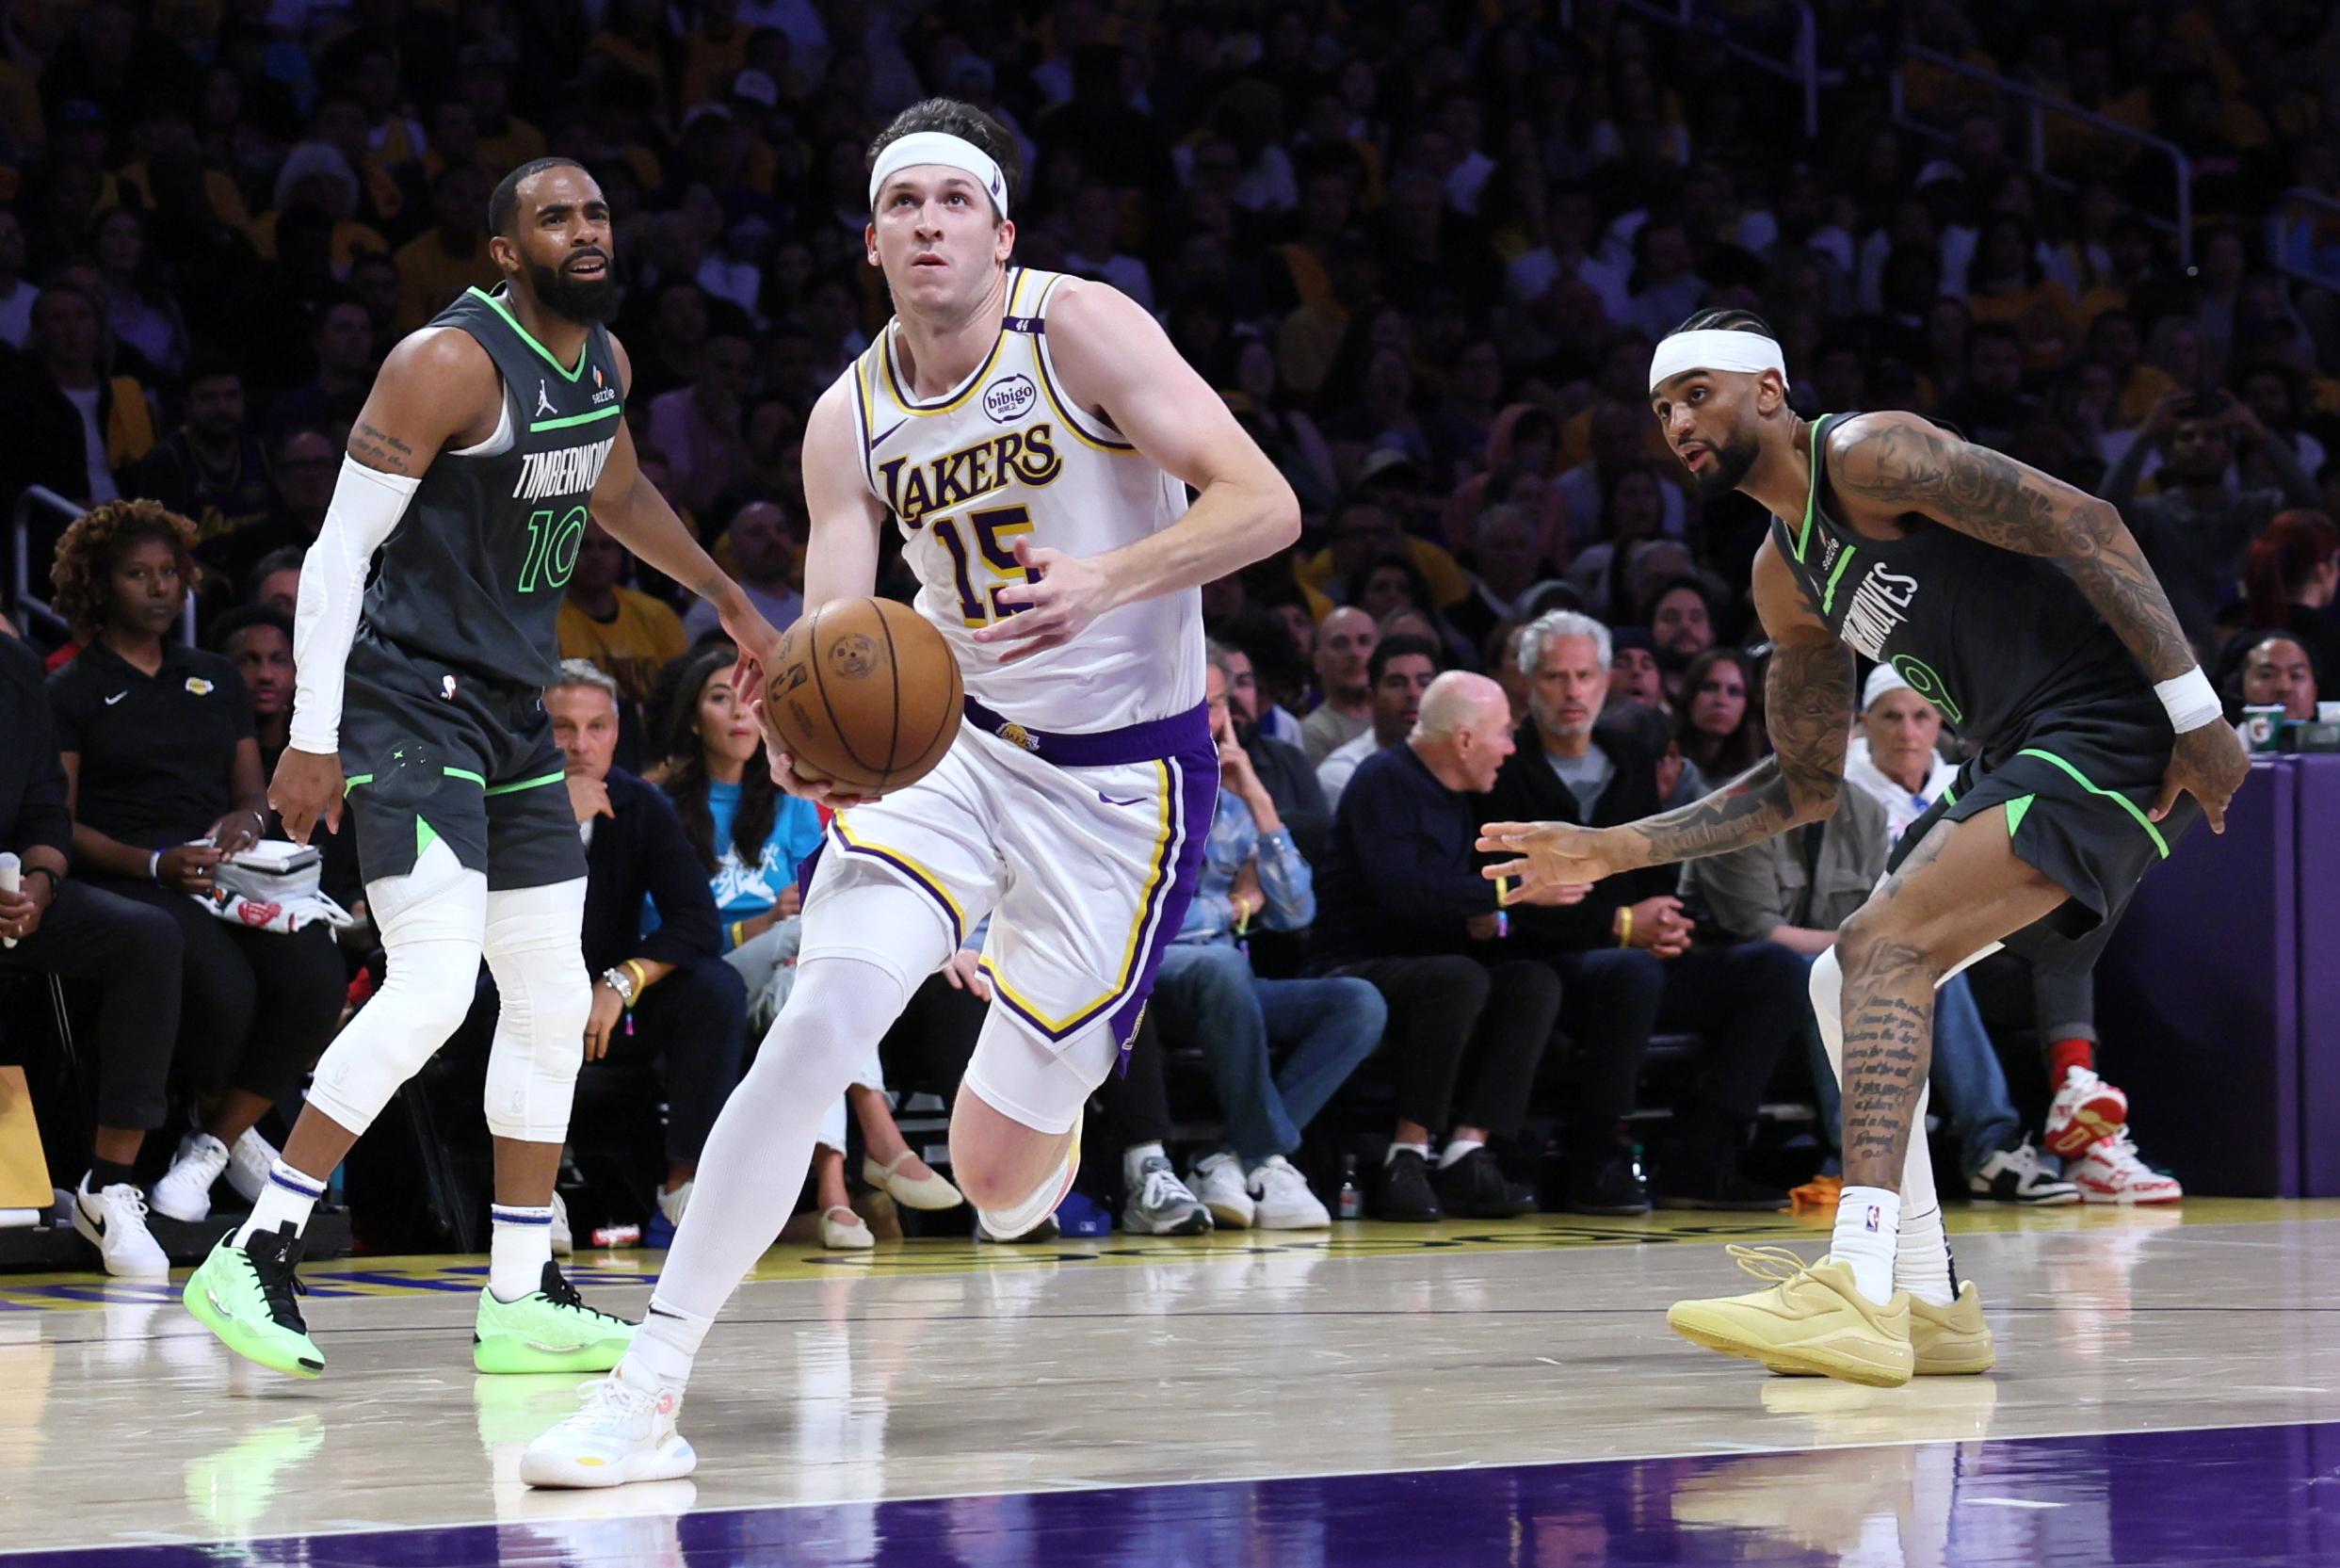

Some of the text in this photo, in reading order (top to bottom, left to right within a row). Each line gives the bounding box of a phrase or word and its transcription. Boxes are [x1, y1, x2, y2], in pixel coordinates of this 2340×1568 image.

[1016, 319, 1030, 331] 44
[591, 386, 616, 405] sezzle
[987, 386, 1033, 410] bibigo
[877, 422, 1064, 530] LAKERS
[518, 505, 589, 592] 10
[932, 503, 1042, 628] 15
[1821, 538, 1840, 572] sezzle
